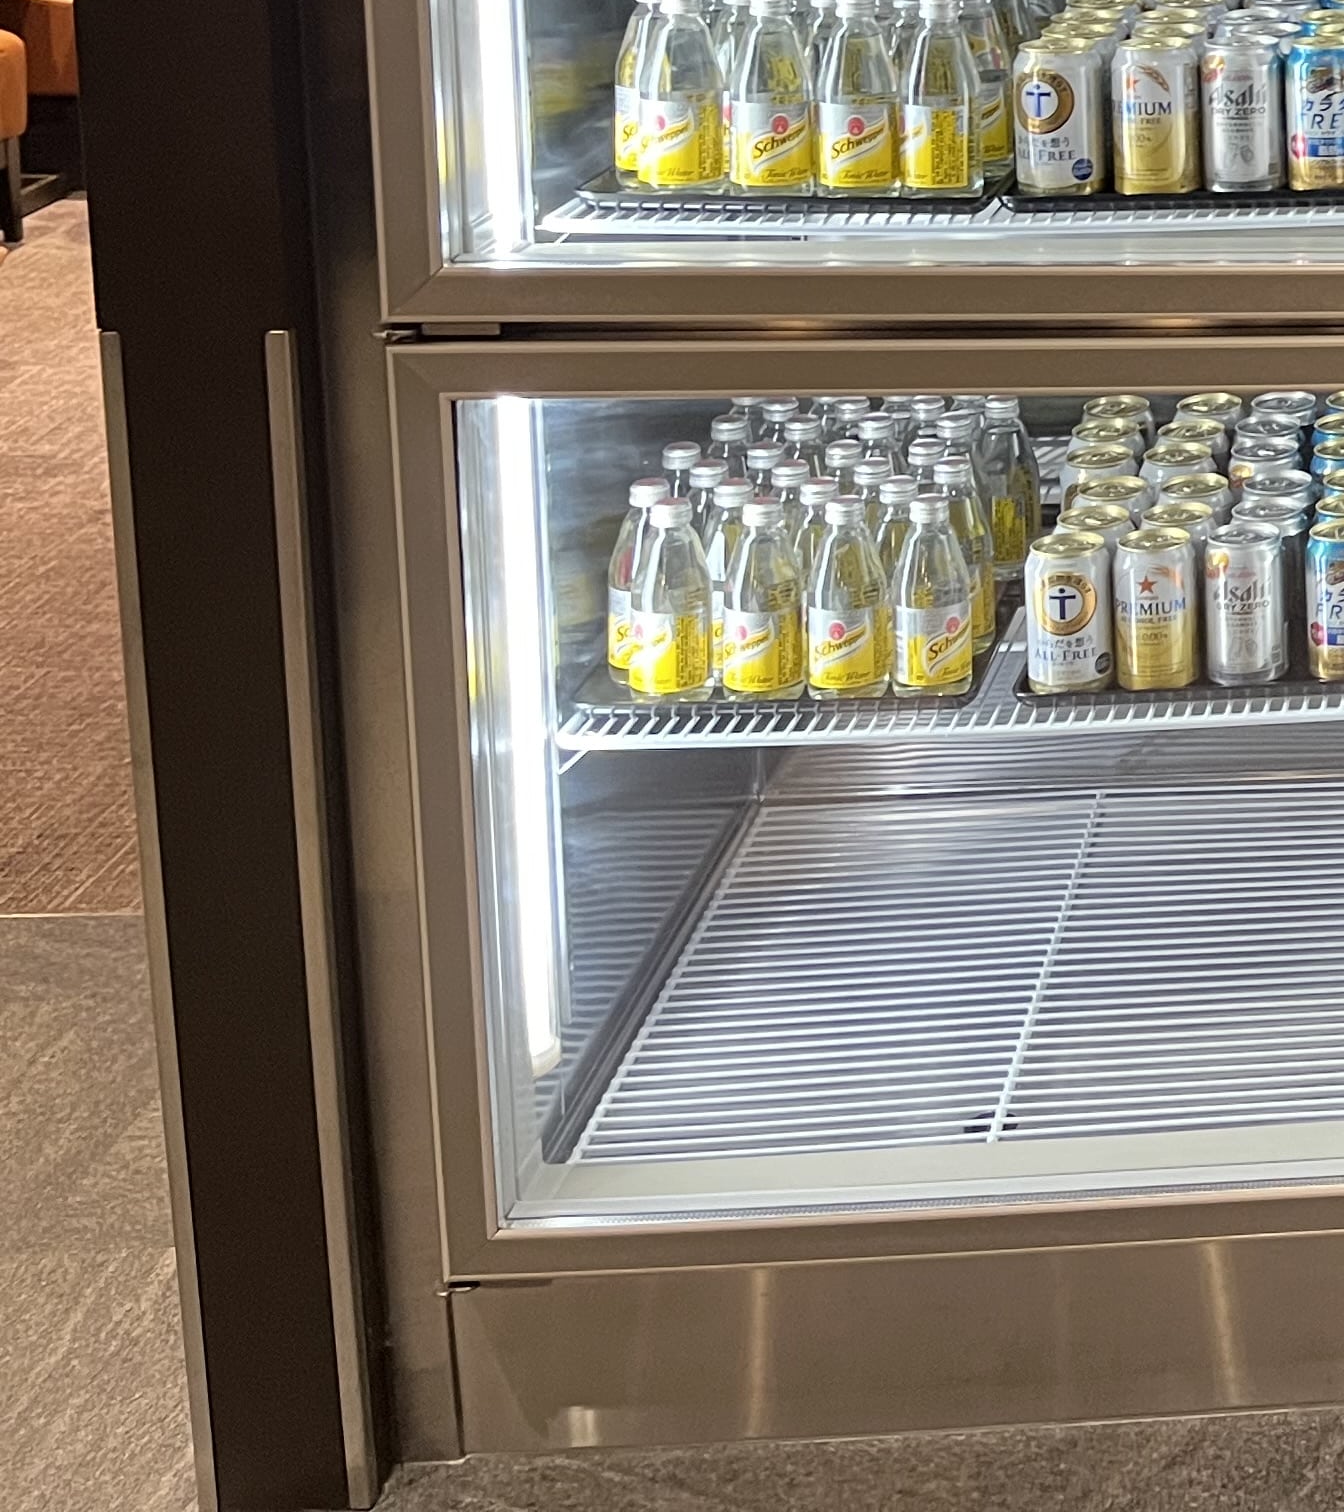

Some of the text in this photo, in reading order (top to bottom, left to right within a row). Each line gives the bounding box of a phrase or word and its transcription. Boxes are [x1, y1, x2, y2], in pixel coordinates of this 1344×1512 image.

[1208, 83, 1266, 108] Asahi
[1233, 106, 1266, 116] ZERO
[1115, 597, 1186, 616] PREMIUM
